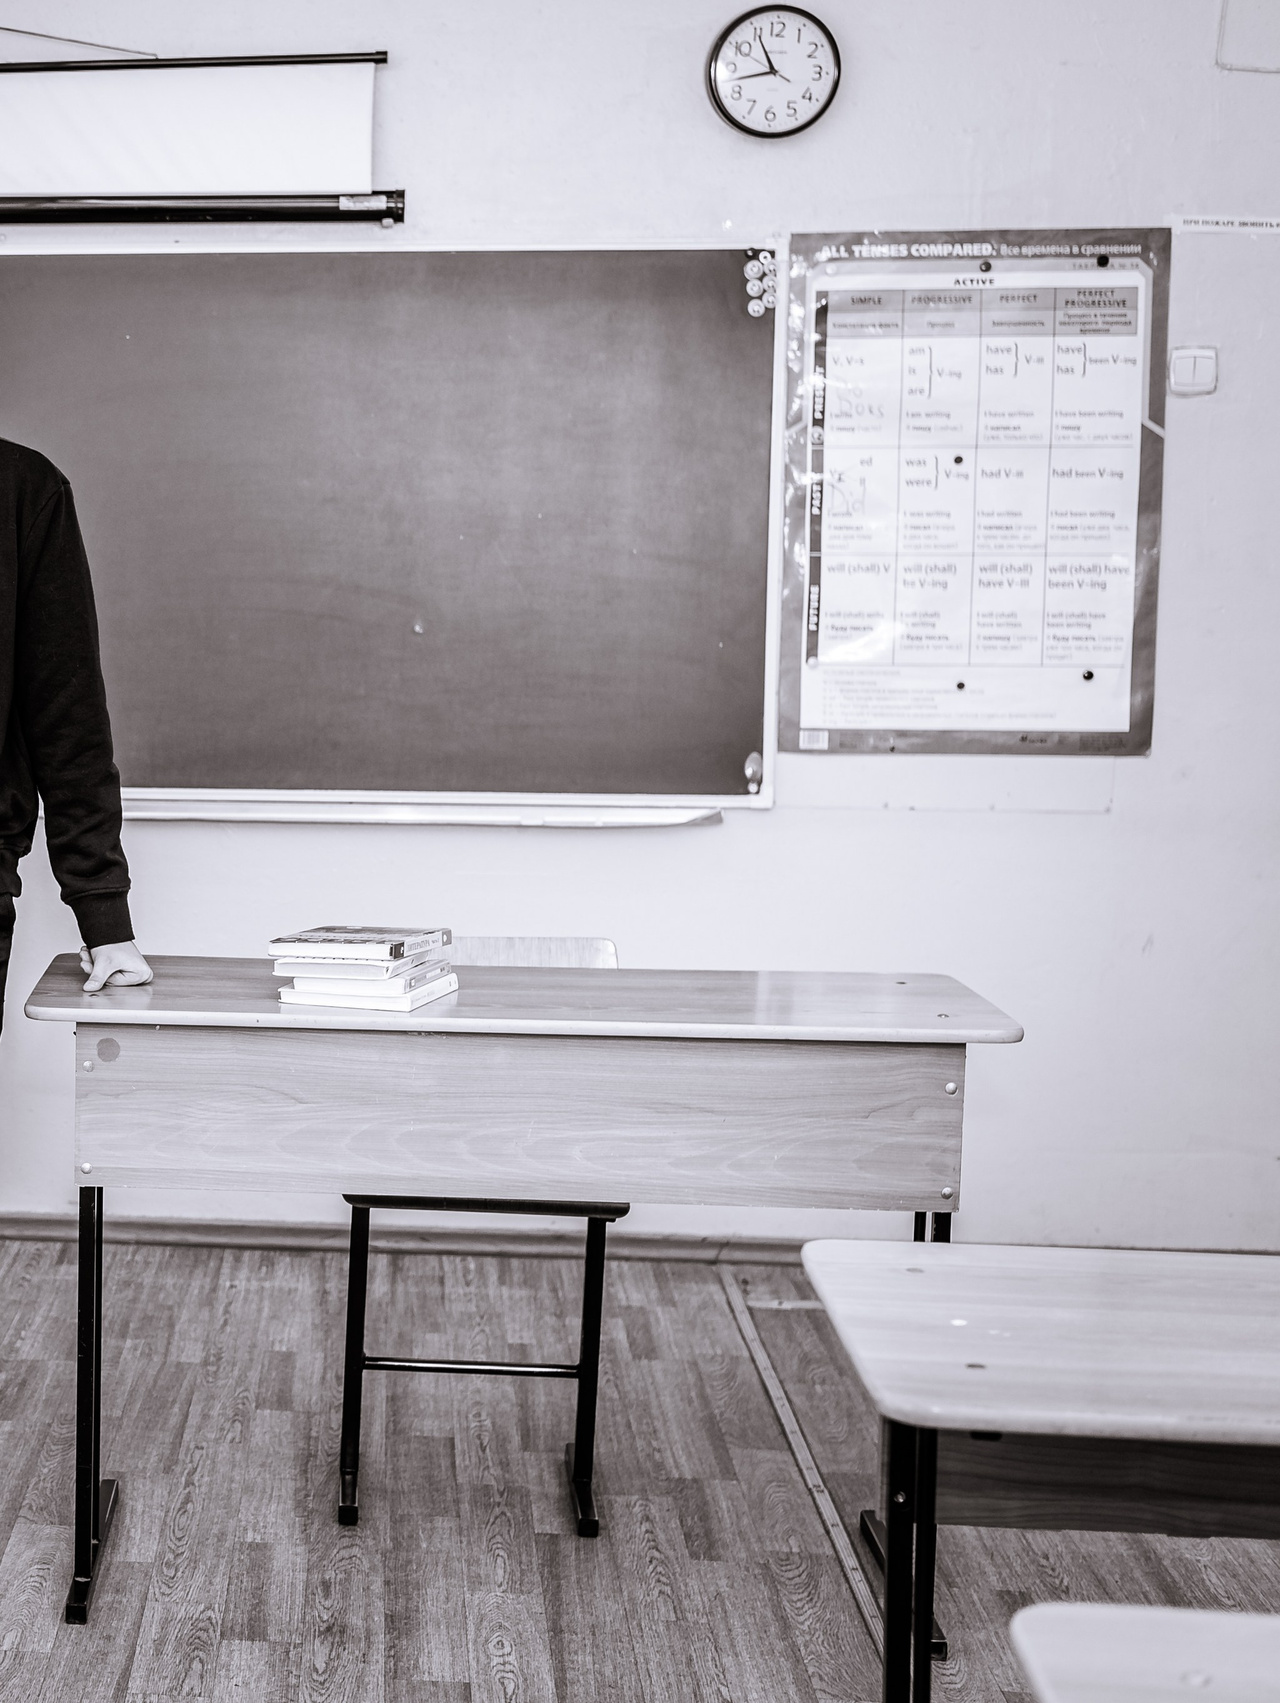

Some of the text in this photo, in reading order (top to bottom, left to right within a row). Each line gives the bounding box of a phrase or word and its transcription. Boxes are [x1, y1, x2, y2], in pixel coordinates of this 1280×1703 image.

[753, 26, 763, 42] 11
[770, 21, 787, 38] 12
[797, 27, 802, 44] 1
[735, 40, 752, 57] 10
[806, 41, 819, 59] 2
[811, 64, 823, 82] 3
[730, 84, 742, 101] 8
[801, 86, 813, 104] 4
[746, 98, 757, 116] 7
[786, 100, 798, 118] 5
[764, 105, 776, 122] 6
[822, 245, 849, 259] ALL
[852, 243, 908, 258] TENSES
[1000, 244, 1019, 256] Все
[1021, 244, 1070, 257] времена
[1072, 246, 1079, 255] в
[1080, 244, 1142, 257] сравнении
[954, 278, 996, 287] ACTIVE
[999, 294, 1038, 303] PERFECT
[1076, 289, 1115, 297] PERFECT
[850, 296, 882, 305] SIMPLE
[910, 295, 973, 305] PROGRESSIVE
[1064, 299, 1127, 308] PROGRESSIVE
[986, 343, 1012, 354] have
[1057, 343, 1082, 354] have
[985, 365, 1004, 375] has
[1056, 365, 1075, 375] has
[907, 387, 925, 395] are
[905, 458, 927, 467] was
[981, 468, 1001, 479] had
[1052, 468, 1073, 478] had
[905, 479, 932, 487] were
[827, 563, 890, 575] will (shall) V
[903, 563, 957, 575] will (shall)
[979, 563, 1033, 576] will (shall)
[1048, 563, 1130, 576] will (shall) have
[978, 579, 1004, 588] have
[1048, 580, 1074, 589] been
[808, 584, 820, 631] FUTURE
